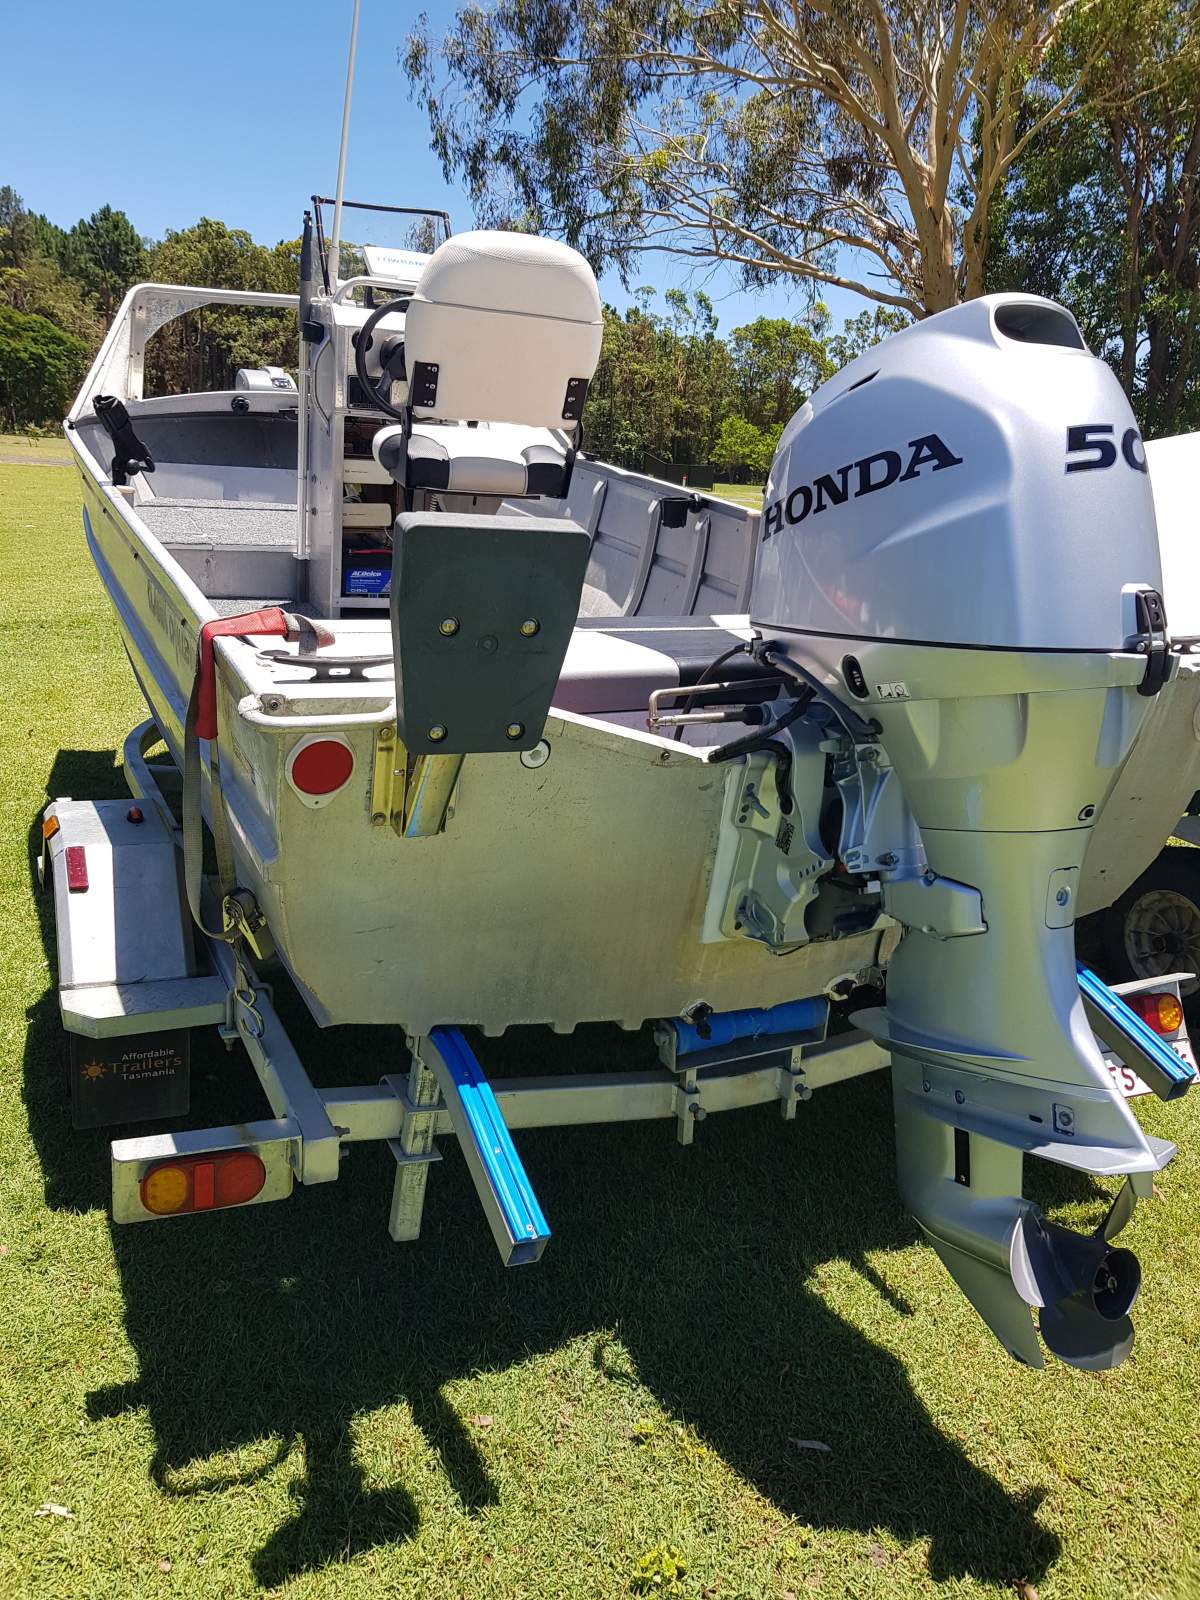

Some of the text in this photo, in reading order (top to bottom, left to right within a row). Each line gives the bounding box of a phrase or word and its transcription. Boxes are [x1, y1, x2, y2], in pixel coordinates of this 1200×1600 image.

[1064, 424, 1148, 475] 50
[762, 433, 964, 542] HONDA
[121, 1048, 175, 1061] Affordable
[111, 1057, 182, 1073] Trailers
[121, 1067, 176, 1081] Tasmania
